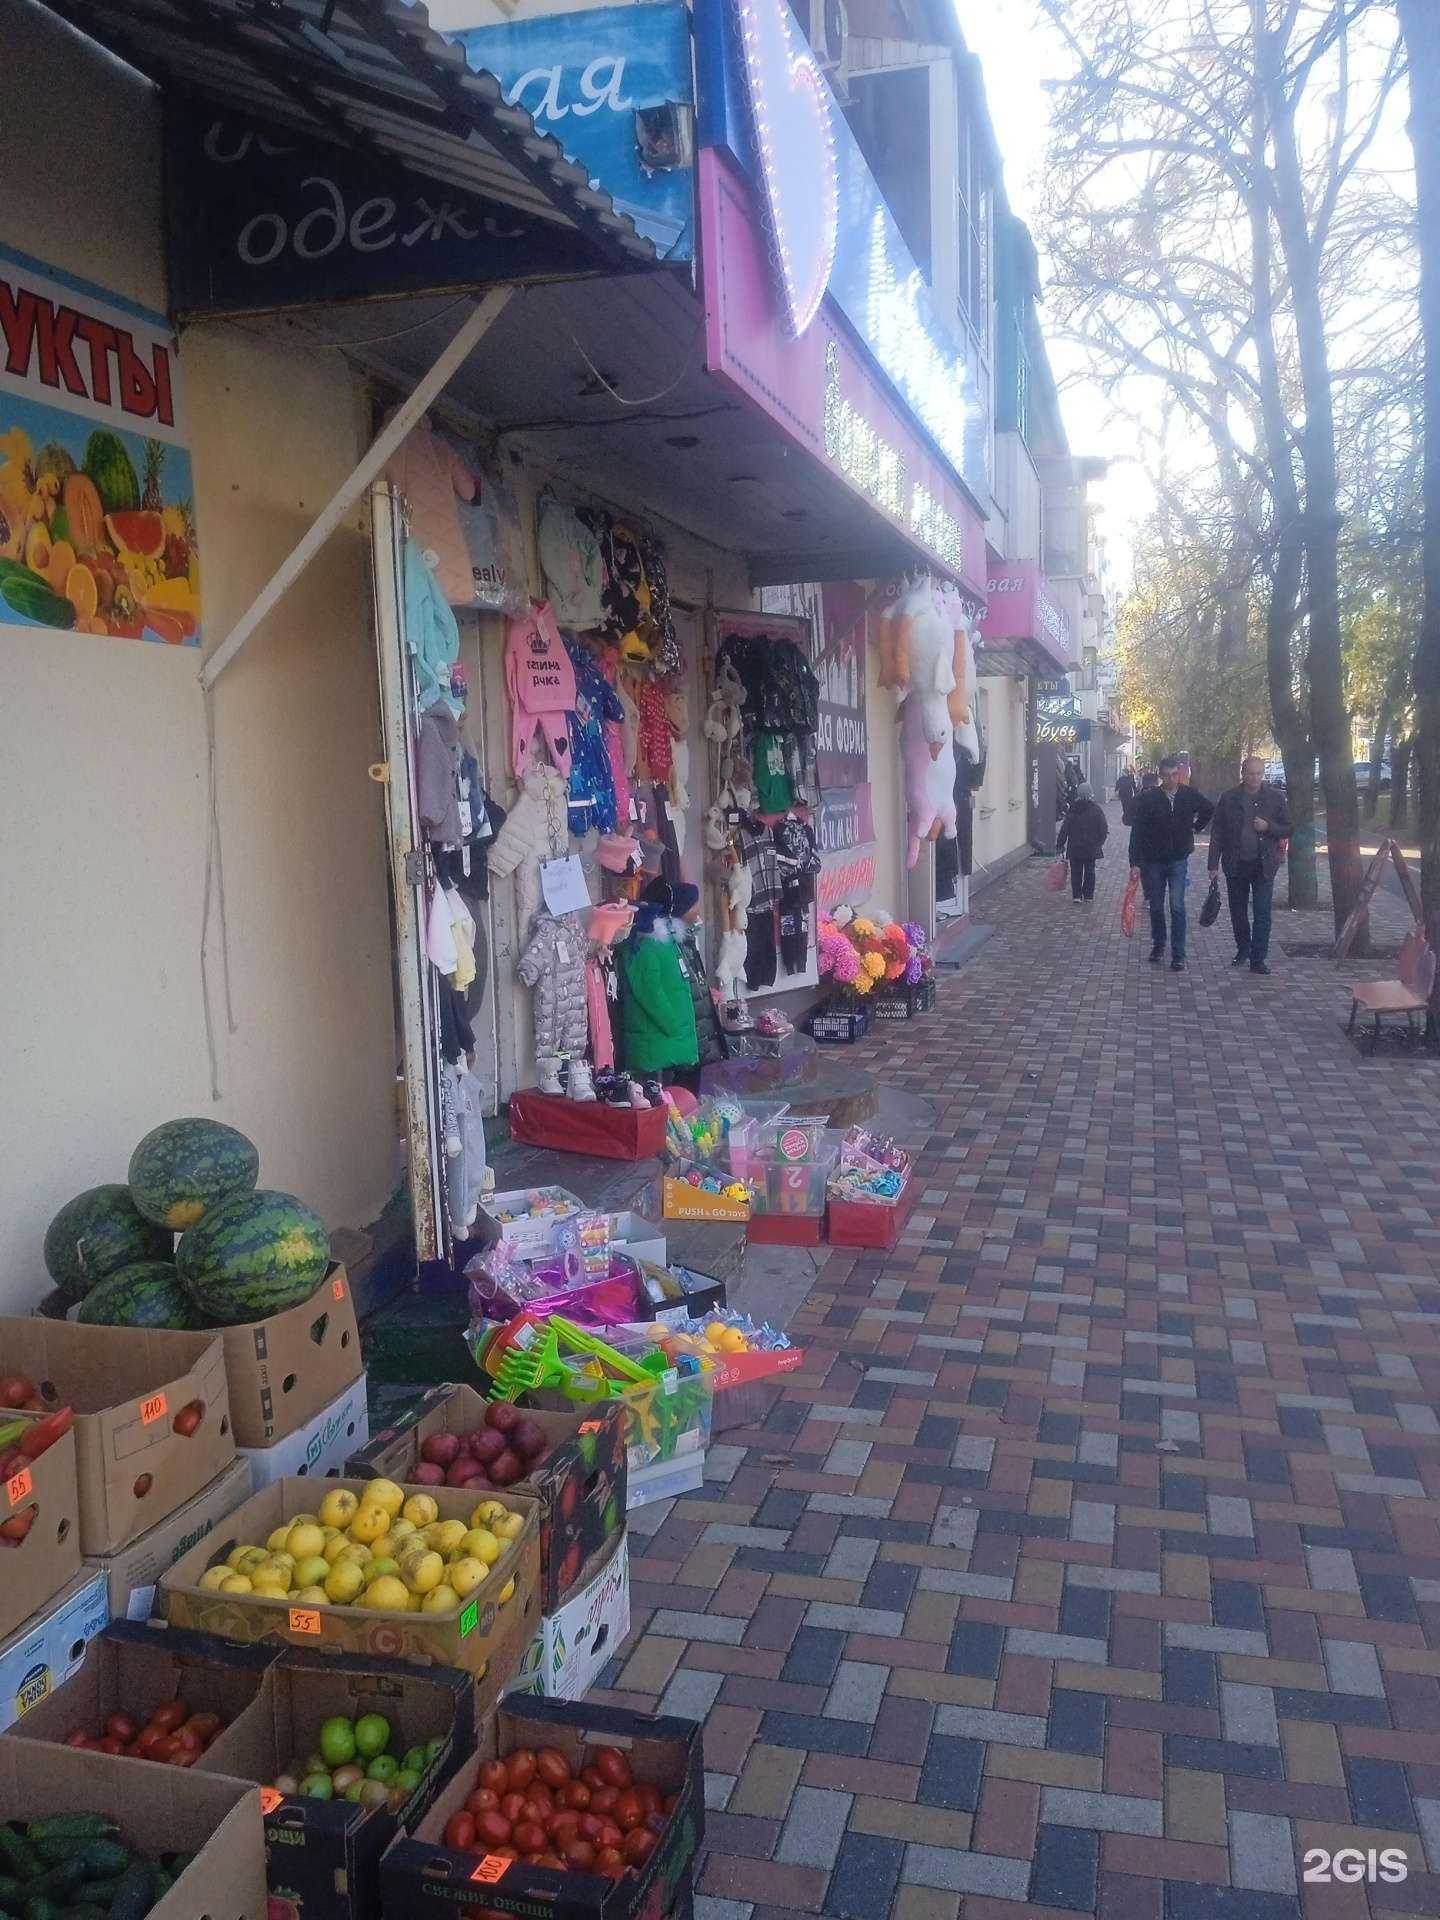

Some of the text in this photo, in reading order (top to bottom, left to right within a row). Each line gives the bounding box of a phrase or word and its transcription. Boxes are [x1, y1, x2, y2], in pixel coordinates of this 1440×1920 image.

[502, 56, 632, 120] ая
[836, 716, 866, 754] ФОРМА
[678, 1207, 704, 1217] PUSH
[712, 1208, 727, 1217] GO
[728, 1210, 746, 1218] TOYS
[291, 1615, 314, 1630] 55
